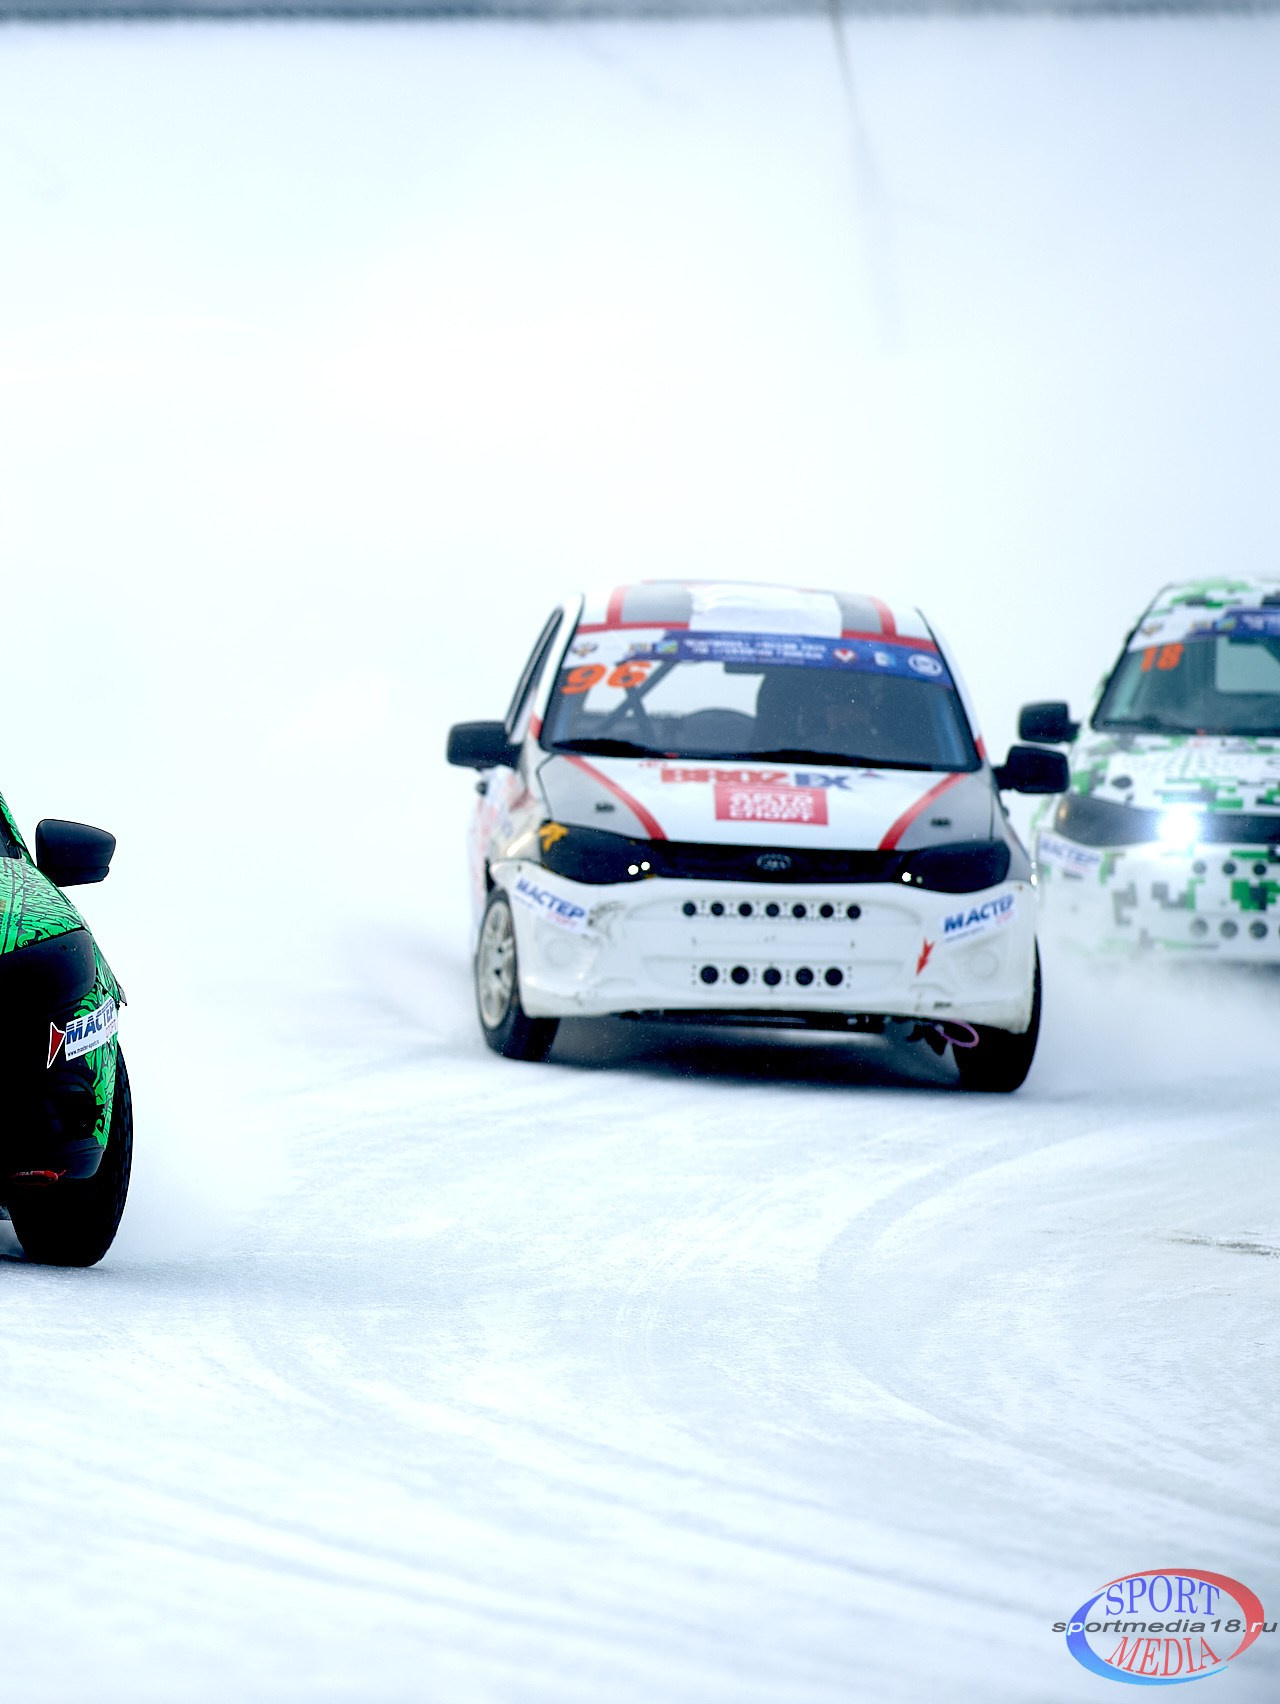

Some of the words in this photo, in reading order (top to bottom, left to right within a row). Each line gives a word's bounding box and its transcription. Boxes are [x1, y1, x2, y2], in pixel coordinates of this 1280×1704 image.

[1141, 642, 1184, 673] 18
[560, 660, 652, 696] 96
[516, 878, 586, 918] МАСТЕР
[66, 998, 114, 1045] МАСТЕР
